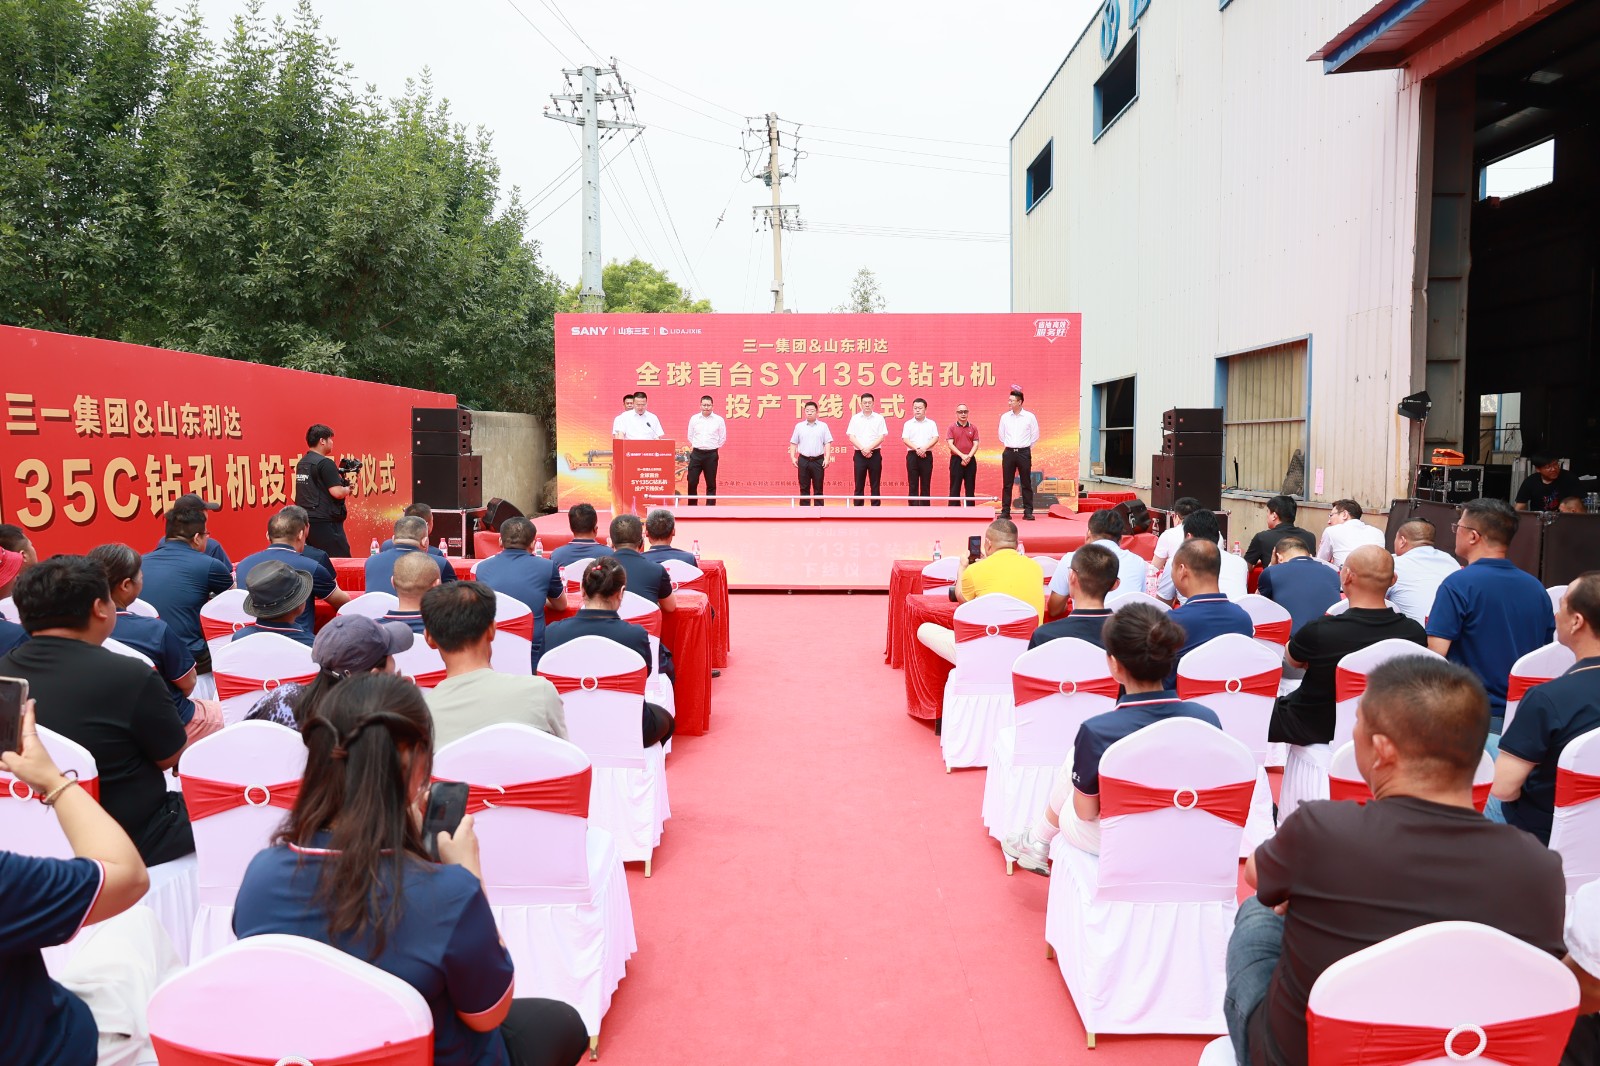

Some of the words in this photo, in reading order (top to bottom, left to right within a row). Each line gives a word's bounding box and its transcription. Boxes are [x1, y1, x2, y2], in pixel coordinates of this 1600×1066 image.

[571, 326, 609, 336] SANY
[618, 327, 650, 336] 山东三汇
[742, 338, 889, 354] 三一集团&山东利达
[635, 361, 997, 387] 全球首台SY135C钻孔机
[5, 392, 243, 438] 三一集团&山东利达
